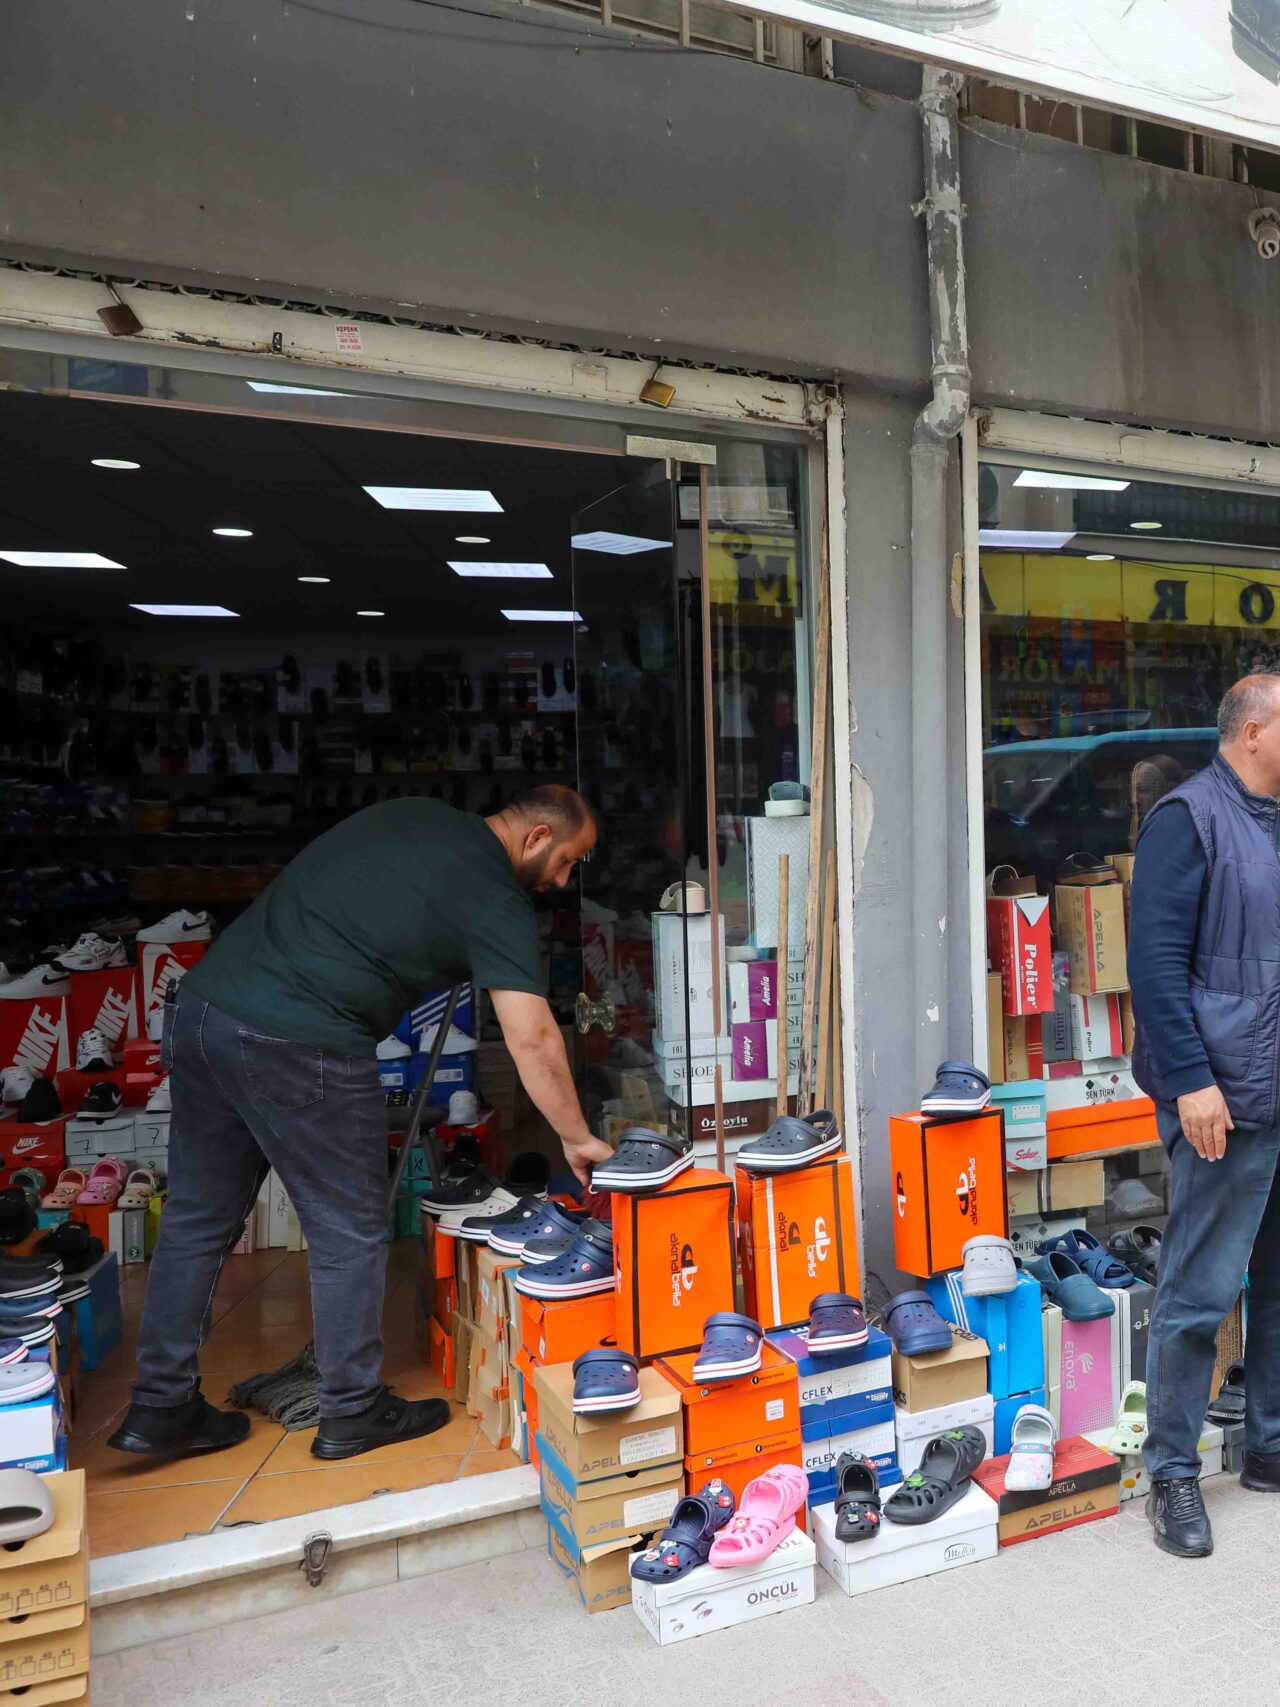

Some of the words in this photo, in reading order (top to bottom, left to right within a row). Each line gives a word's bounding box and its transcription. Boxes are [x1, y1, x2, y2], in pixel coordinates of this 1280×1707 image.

[1092, 908, 1106, 973] APELLA
[761, 975, 770, 1006] Amelia
[12, 1004, 62, 1072] NIKE
[743, 1035, 754, 1067] Amelia
[701, 1114, 749, 1130] Özoylu
[1064, 1340, 1077, 1390] enova
[801, 1385, 833, 1401] CFLEX
[580, 1455, 621, 1473] APEL
[805, 1451, 837, 1468] CFLEX
[1048, 1482, 1077, 1497] APELLA
[1024, 1500, 1097, 1530] APELLA
[747, 1580, 799, 1605] ÖNCÜL
